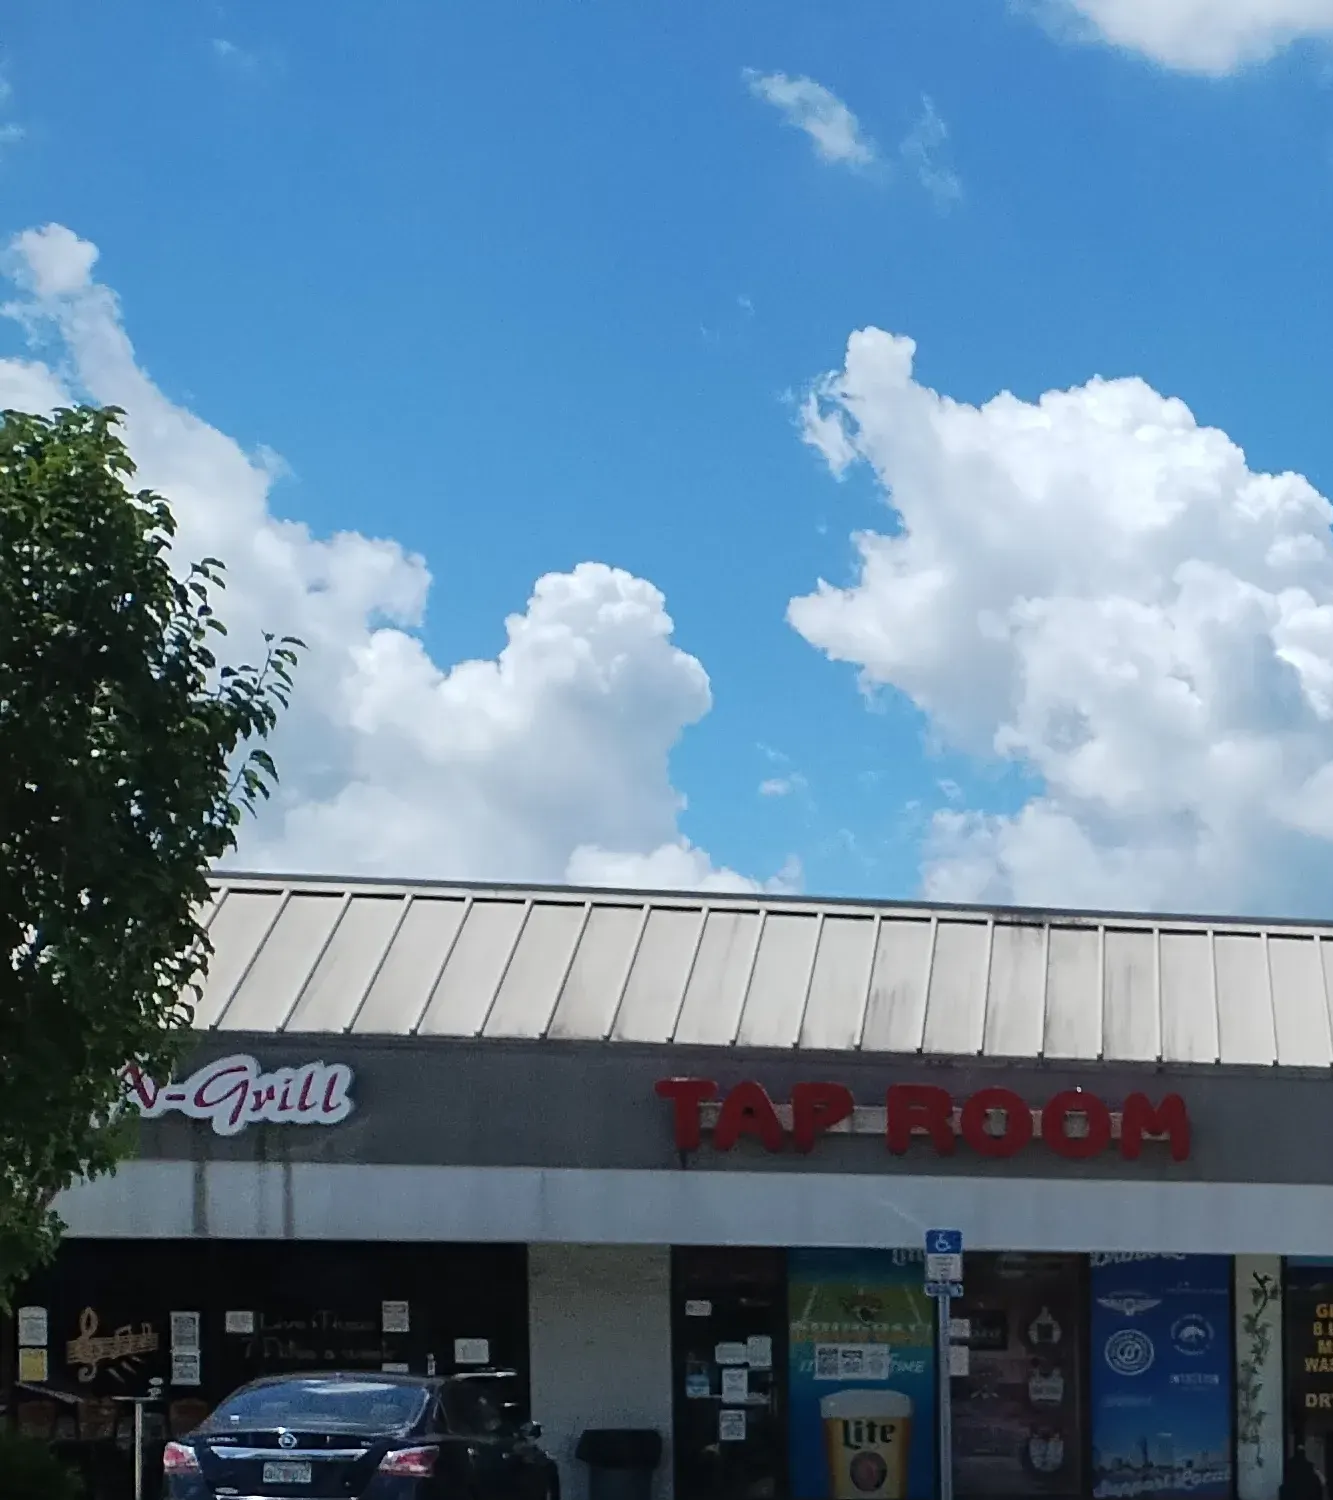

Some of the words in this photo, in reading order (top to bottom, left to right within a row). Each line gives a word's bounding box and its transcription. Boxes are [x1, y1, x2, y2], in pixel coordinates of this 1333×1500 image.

[655, 1078, 854, 1155] TAP
[886, 1083, 1191, 1161] ROOM
[842, 1418, 896, 1451] Lite
